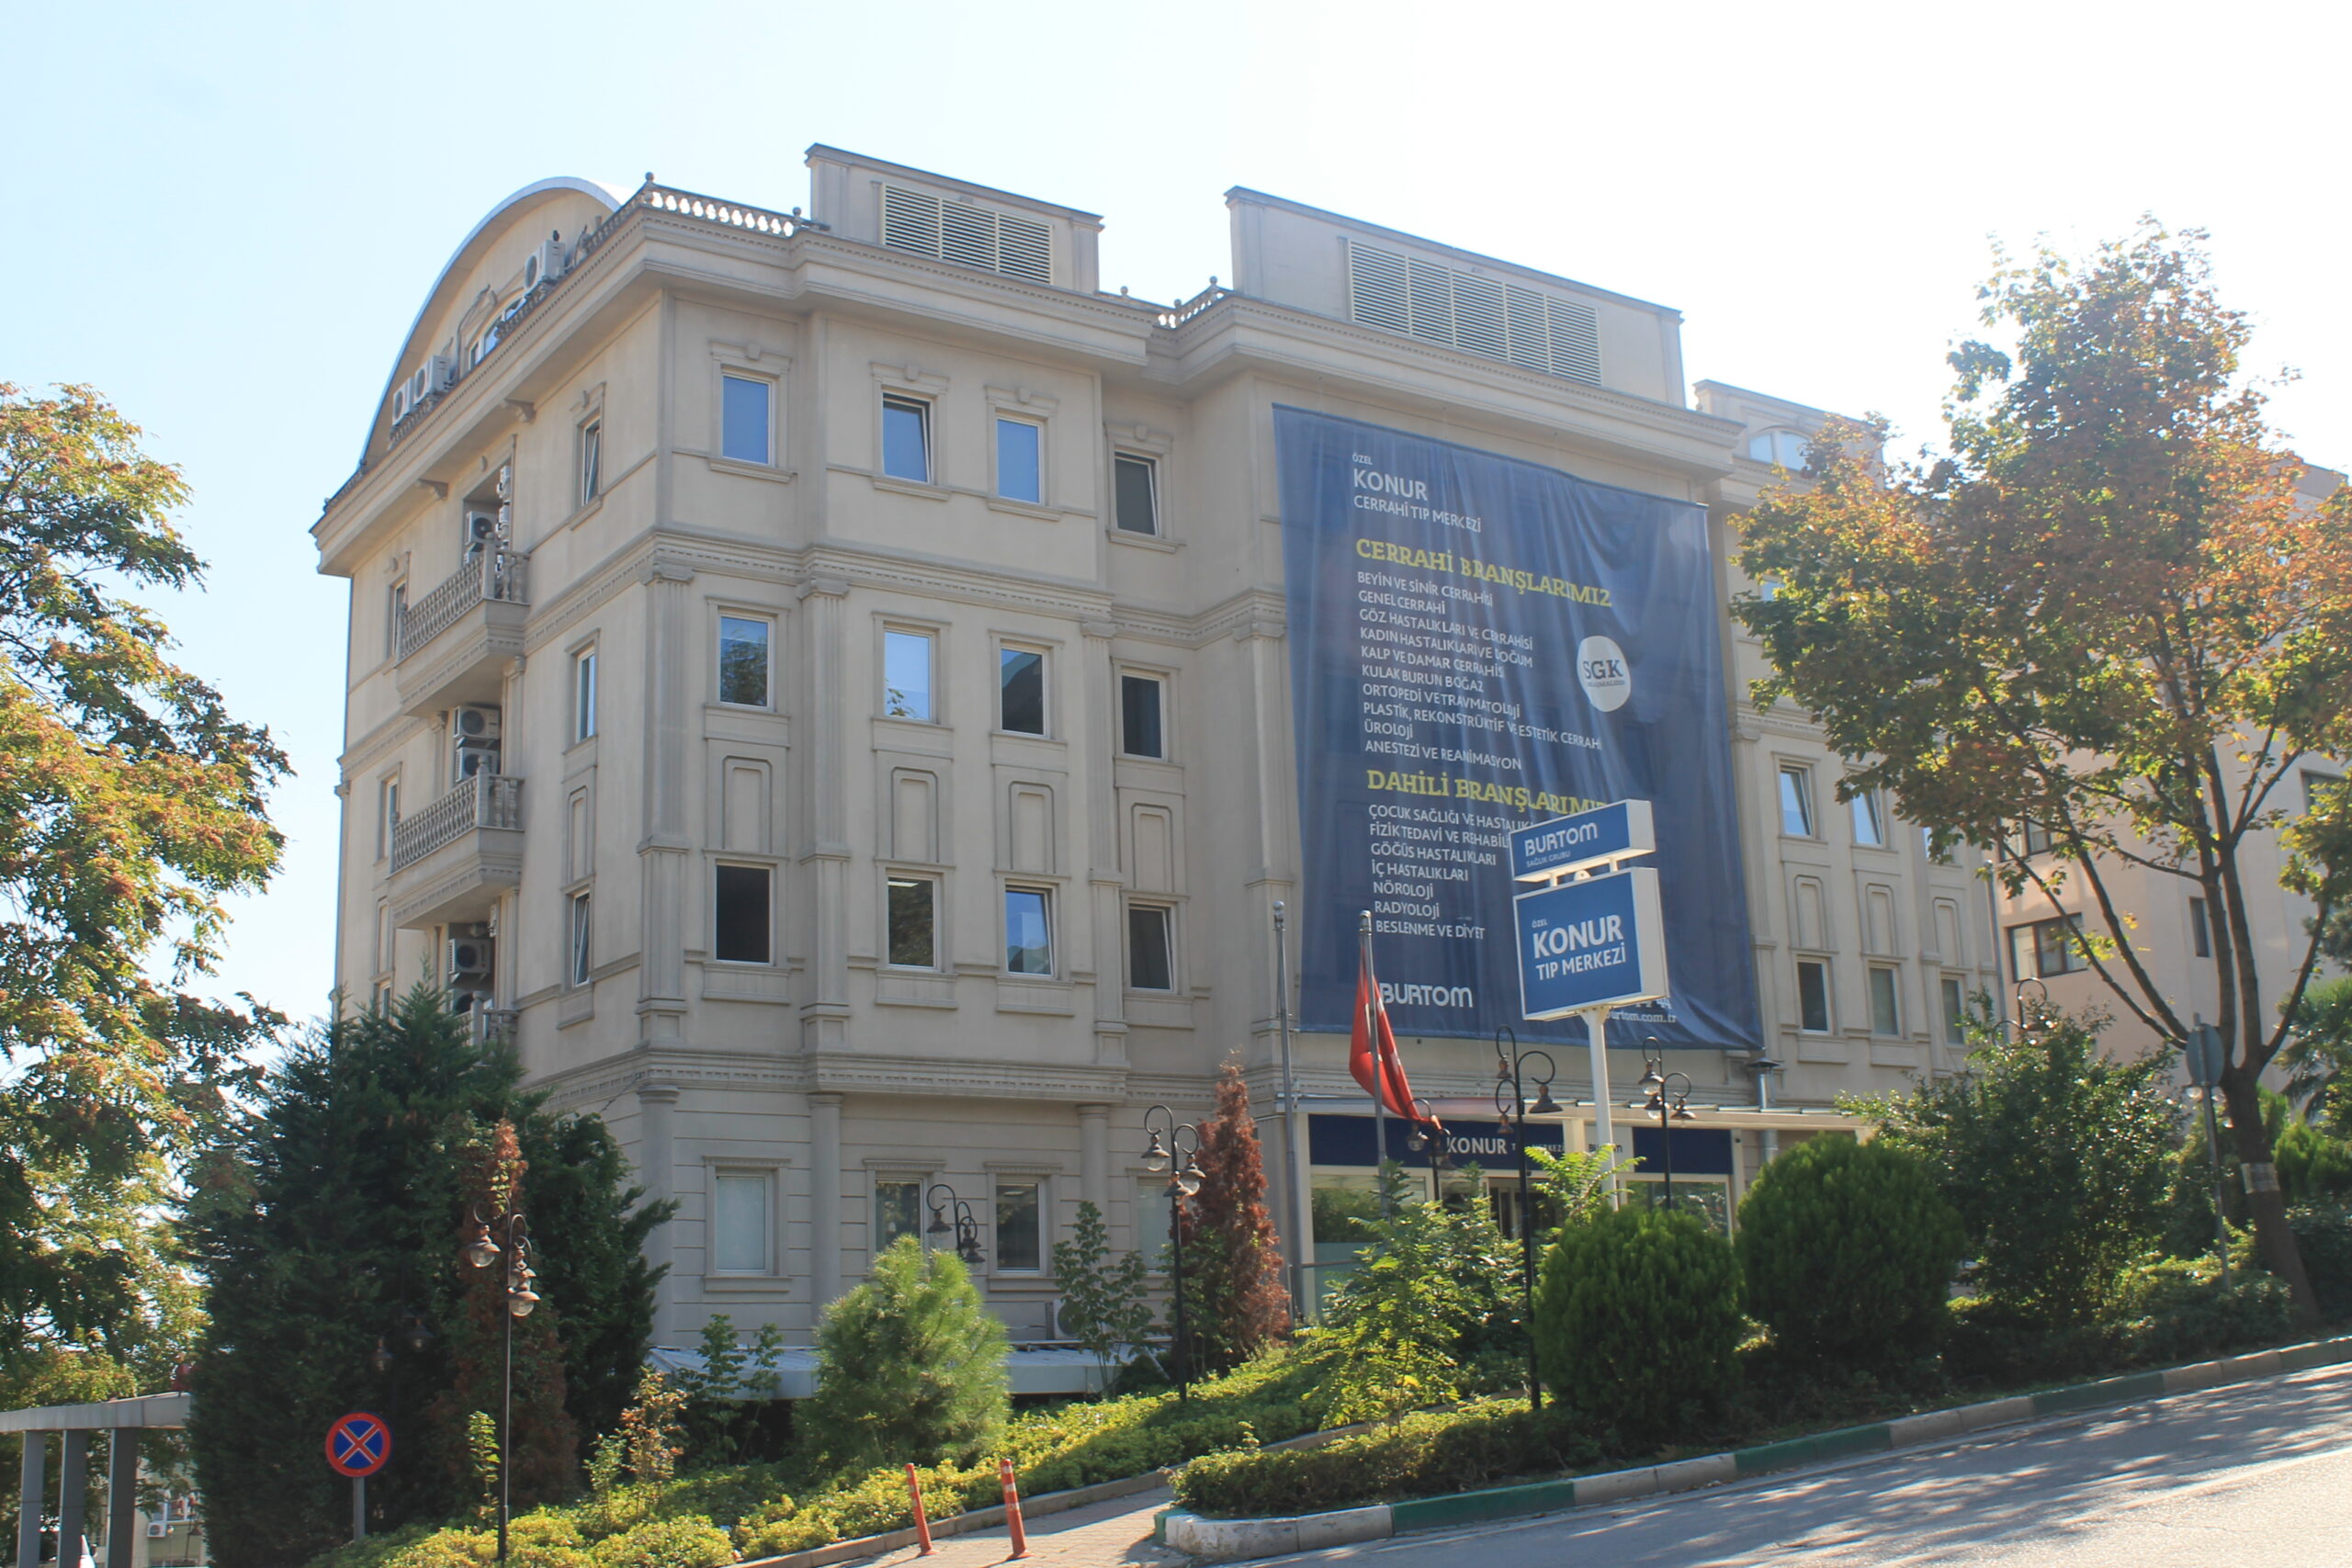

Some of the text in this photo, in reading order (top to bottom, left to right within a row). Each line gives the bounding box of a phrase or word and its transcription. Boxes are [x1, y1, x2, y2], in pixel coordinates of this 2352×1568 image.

[1352, 452, 1373, 465] ÖZEL
[1353, 468, 1428, 502] KONUR
[1354, 495, 1481, 533] CERRAHİ TIP MERKEZİ
[1356, 538, 1611, 606] CERRAHİ BRANŞLARIMIZ
[1358, 571, 1392, 586] BEYİN
[1394, 578, 1407, 591] VE
[1409, 579, 1439, 596] SİNİR
[1358, 590, 1445, 615] GENEL CERRAHİ
[1360, 608, 1386, 623] GÖZ
[1389, 614, 1464, 637] HASTALIKLARI
[1467, 626, 1479, 640] VE
[1360, 627, 1397, 642] KADIN
[1400, 633, 1476, 655] HASTALIKLARI
[1477, 646, 1492, 659] VE
[1361, 646, 1390, 660] KALP
[1393, 649, 1406, 663] VE
[1408, 652, 1450, 669] DAMAR
[1583, 660, 1623, 679] SGK
[1362, 664, 1484, 693] KULAK BURUN BOĞAZ
[1363, 683, 1521, 719] ORTOPEDİ VE TRAVMATOLOJİ
[1363, 702, 1412, 721] PLASTİK,
[1414, 709, 1505, 732] REKONSTRÜKTİF
[1507, 721, 1518, 735] VE
[1519, 726, 1558, 743] ESTETİK
[1364, 719, 1413, 740] ÜROLOJİ
[1364, 740, 1522, 770] ANESTEZİ VE REANİMASYON
[1367, 769, 1609, 816] DAHİLİ BRANŞLARIMI
[1369, 805, 1411, 819] ÇOCUK
[1413, 808, 1459, 825] SAĞLIĞI
[1463, 813, 1475, 826] VE
[1370, 821, 1400, 837] FİZİK
[1401, 826, 1442, 841] TEDAVİ
[1445, 831, 1460, 843] VE
[1371, 841, 1496, 865] GÖĞÜS HASTALIKLARI
[1372, 859, 1468, 882] İÇ HASTALIKLARI
[1374, 880, 1433, 900] NÖROLOJİ
[1374, 901, 1440, 919] RADYOLOJİ
[1376, 920, 1485, 940] BESLENME VE DİYET
[1532, 919, 1548, 928] ÖZEL
[1533, 915, 1623, 958] KONUR
[1536, 942, 1626, 980] TIP MERKEZİ
[1447, 1137, 1508, 1155] KONUR
